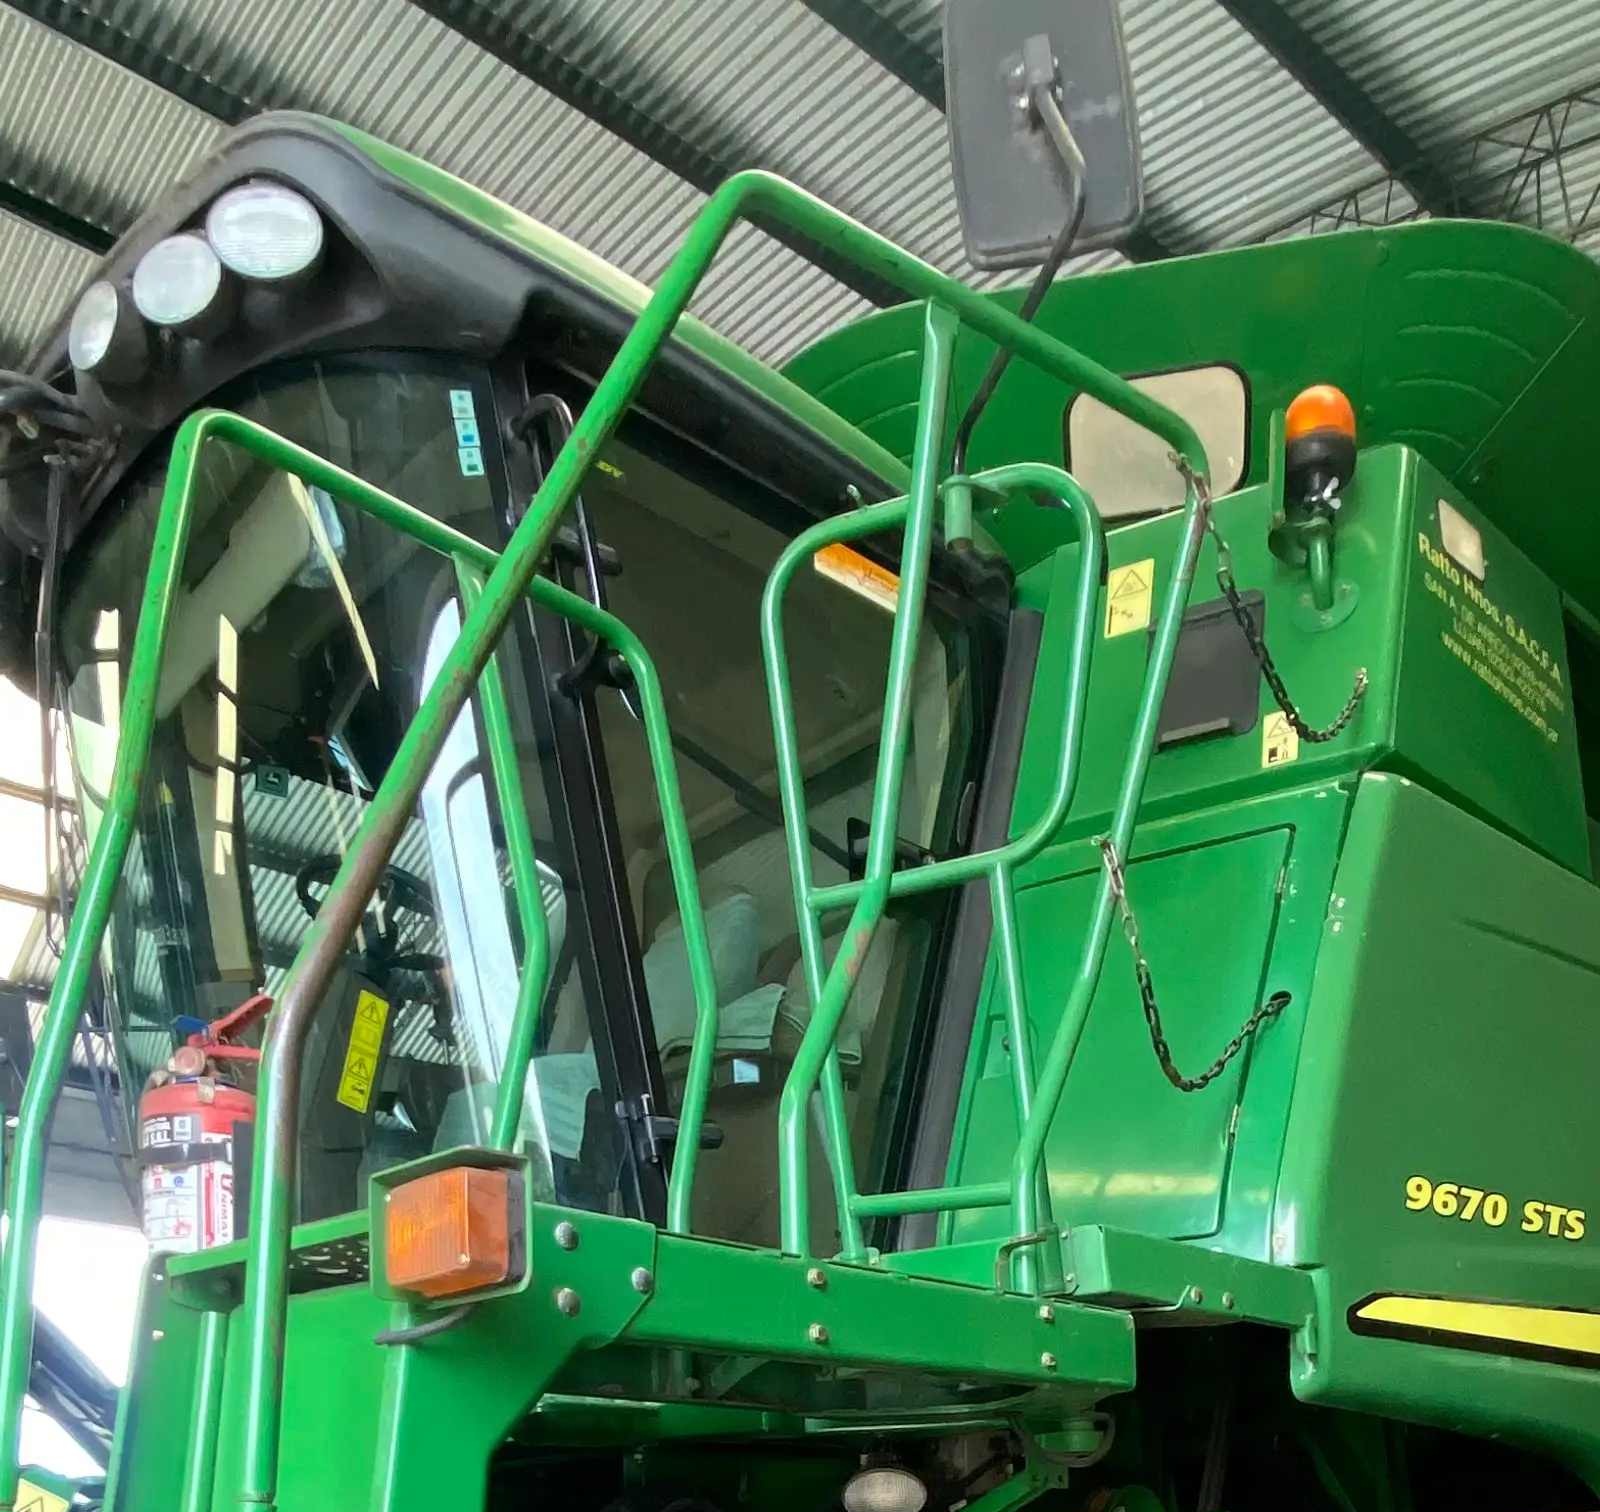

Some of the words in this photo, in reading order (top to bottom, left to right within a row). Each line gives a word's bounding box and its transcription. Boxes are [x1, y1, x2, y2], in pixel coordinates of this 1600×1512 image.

[1417, 531, 1460, 587] Ratto
[1404, 1175, 1509, 1227] 9670
[1520, 1200, 1587, 1240] STS
